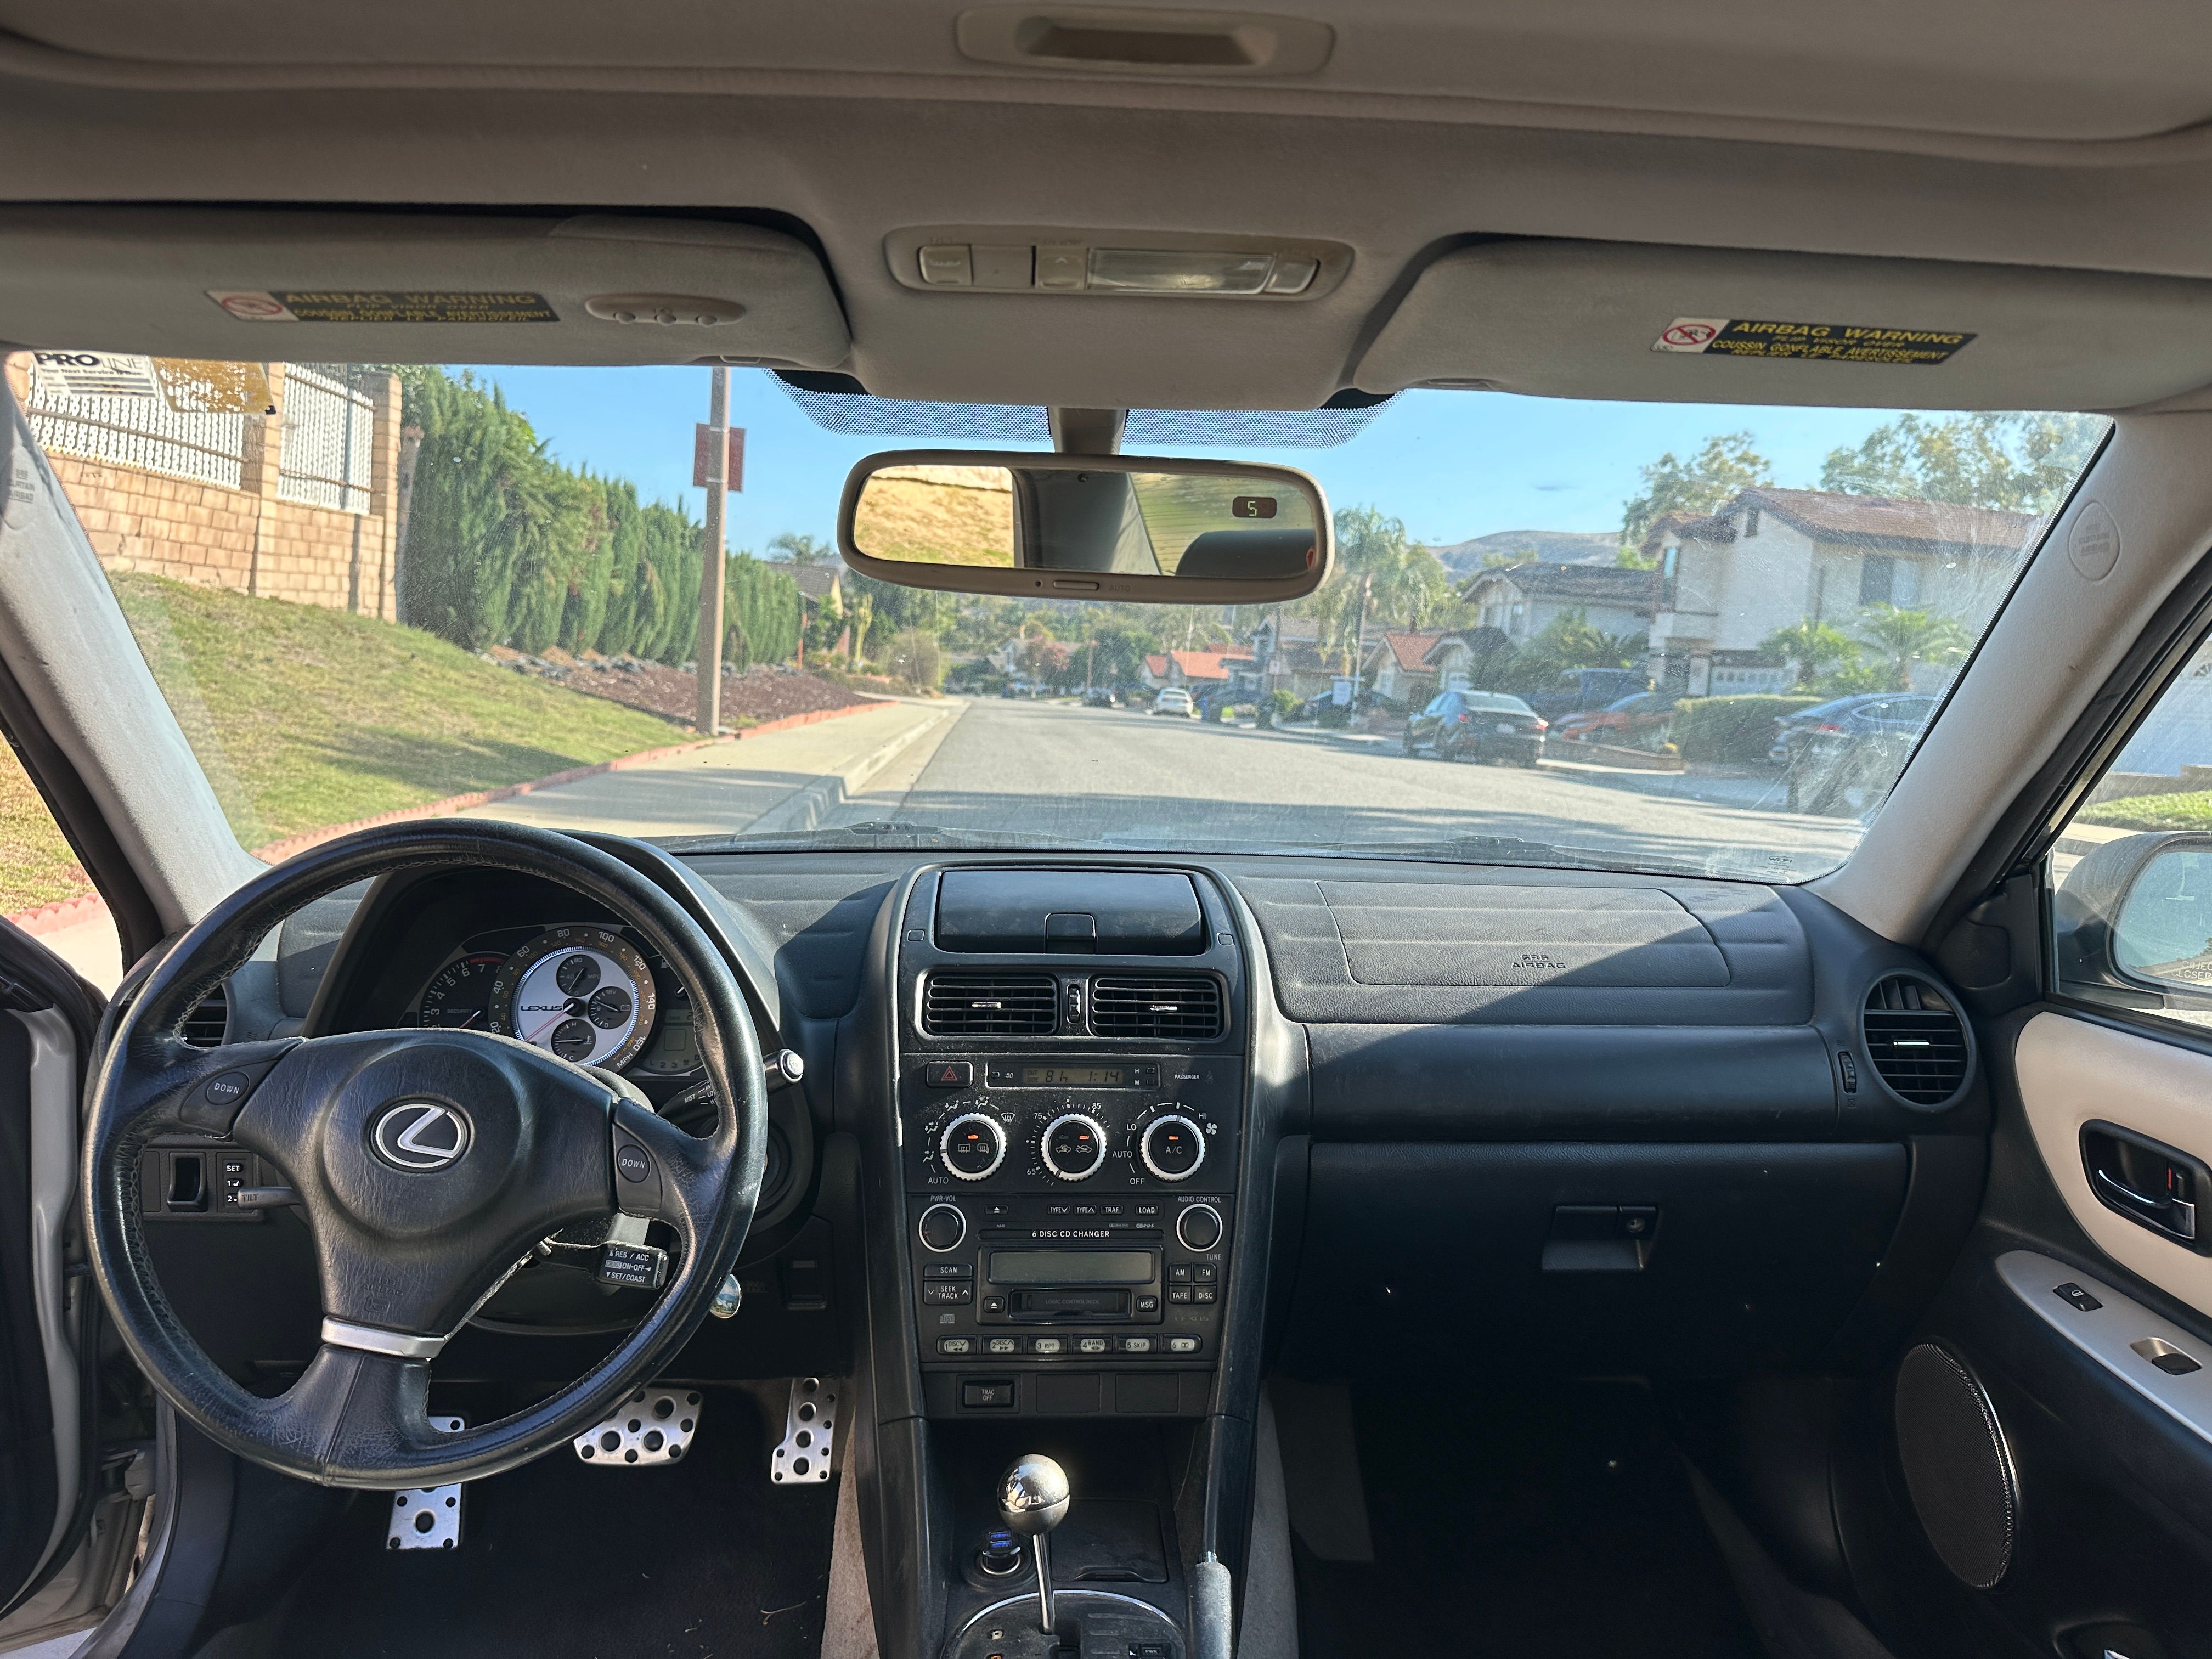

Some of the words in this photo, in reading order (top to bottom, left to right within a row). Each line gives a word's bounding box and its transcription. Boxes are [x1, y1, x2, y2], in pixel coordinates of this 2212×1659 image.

[286, 294, 392, 303] AIRBAG
[404, 294, 536, 304] WARNING
[1732, 321, 1831, 337] AIRBAG
[1844, 326, 1963, 345] WARNING
[557, 928, 570, 938] 80
[598, 931, 615, 943] 100
[517, 946, 530, 957] 60
[478, 963, 486, 973] 7
[633, 955, 646, 971] 120
[461, 967, 470, 977] 6
[446, 977, 456, 987] 5
[493, 980, 504, 994] 40
[437, 991, 445, 1000] 4
[633, 1035, 647, 1052] 160
[616, 1052, 633, 1069] MPH
[1088, 1070, 1119, 1082] 1:14
[214, 1082, 240, 1094] DOWN
[1165, 1146, 1182, 1154] A/C
[622, 1158, 646, 1169] DOWN
[241, 1193, 259, 1202] TILT
[614, 1250, 628, 1259] RES
[635, 1254, 650, 1262] ACC
[622, 1262, 646, 1272] ON-OFF
[611, 1271, 646, 1283] SET/COAST
